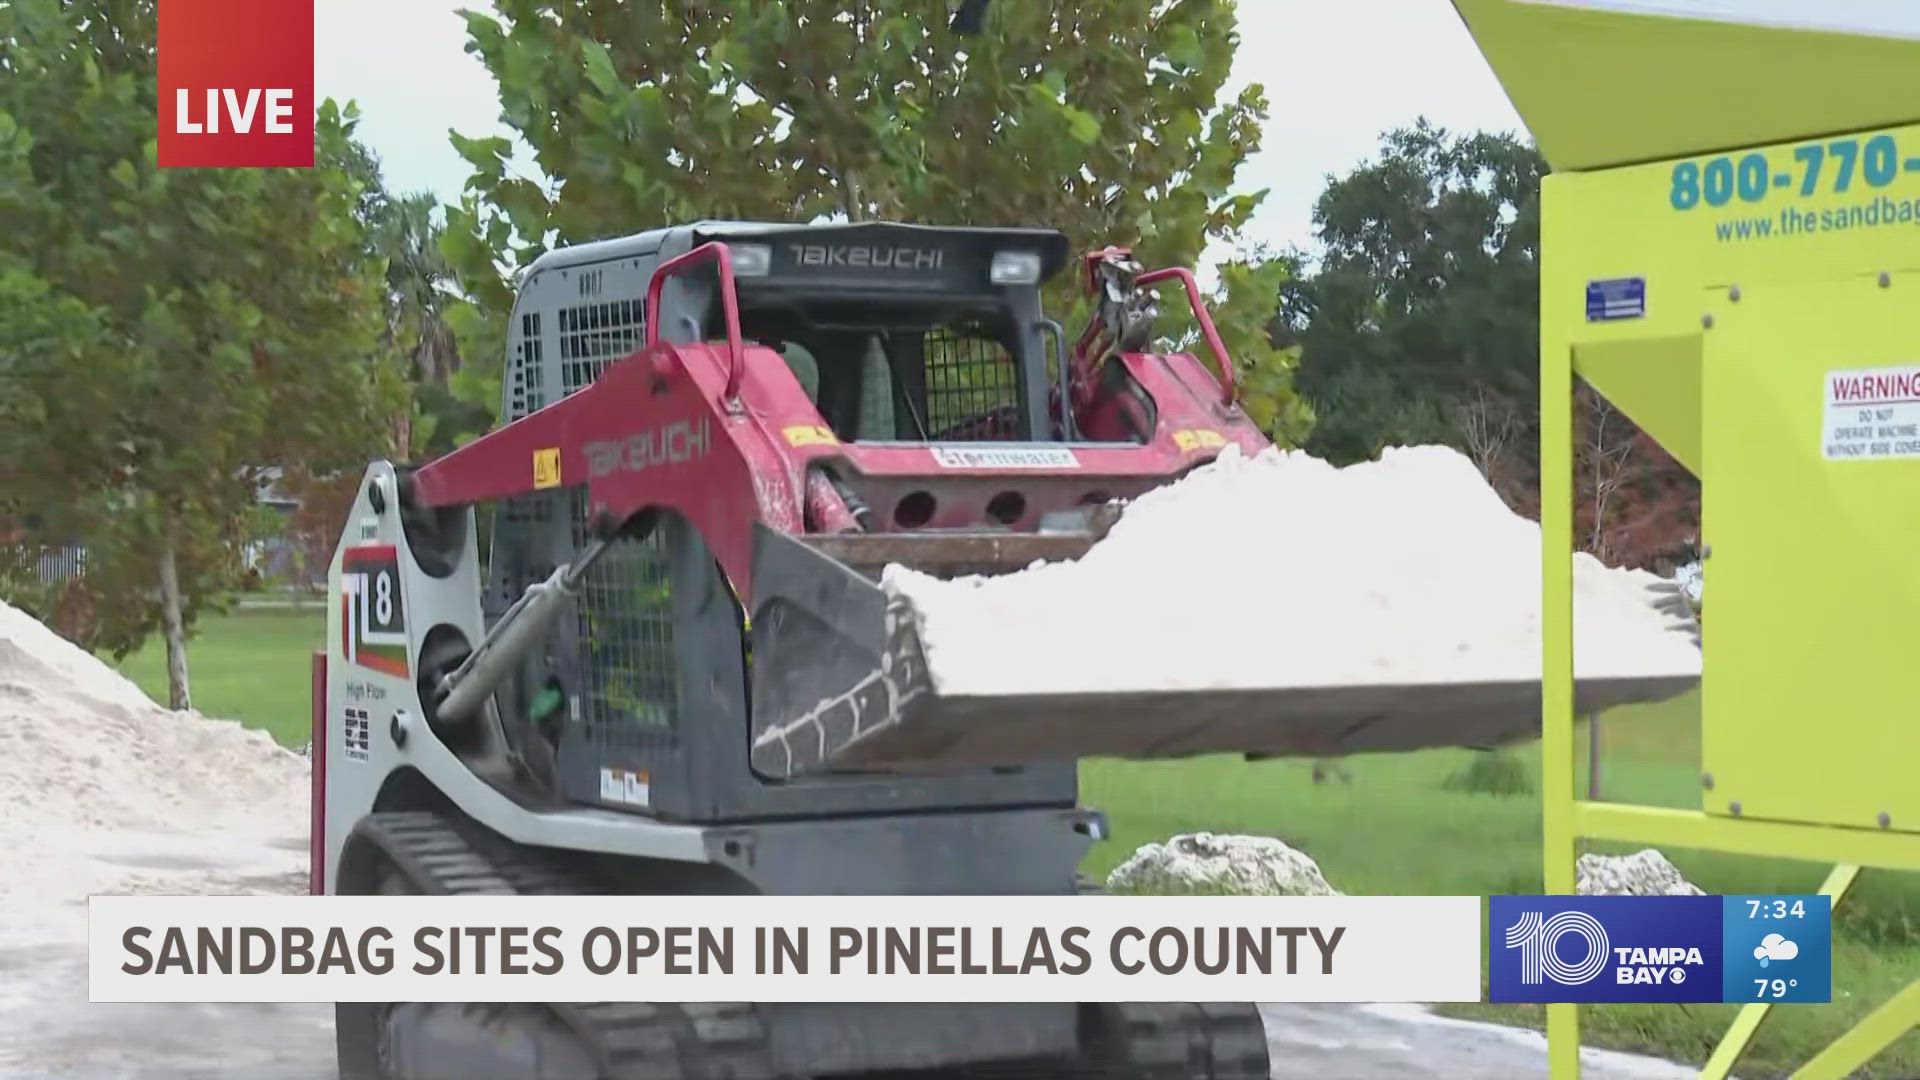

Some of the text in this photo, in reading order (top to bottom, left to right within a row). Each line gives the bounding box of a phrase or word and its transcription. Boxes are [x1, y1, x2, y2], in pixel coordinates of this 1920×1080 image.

[1669, 134, 1920, 211] 800-770-
[1859, 409, 1894, 422] DO NOT
